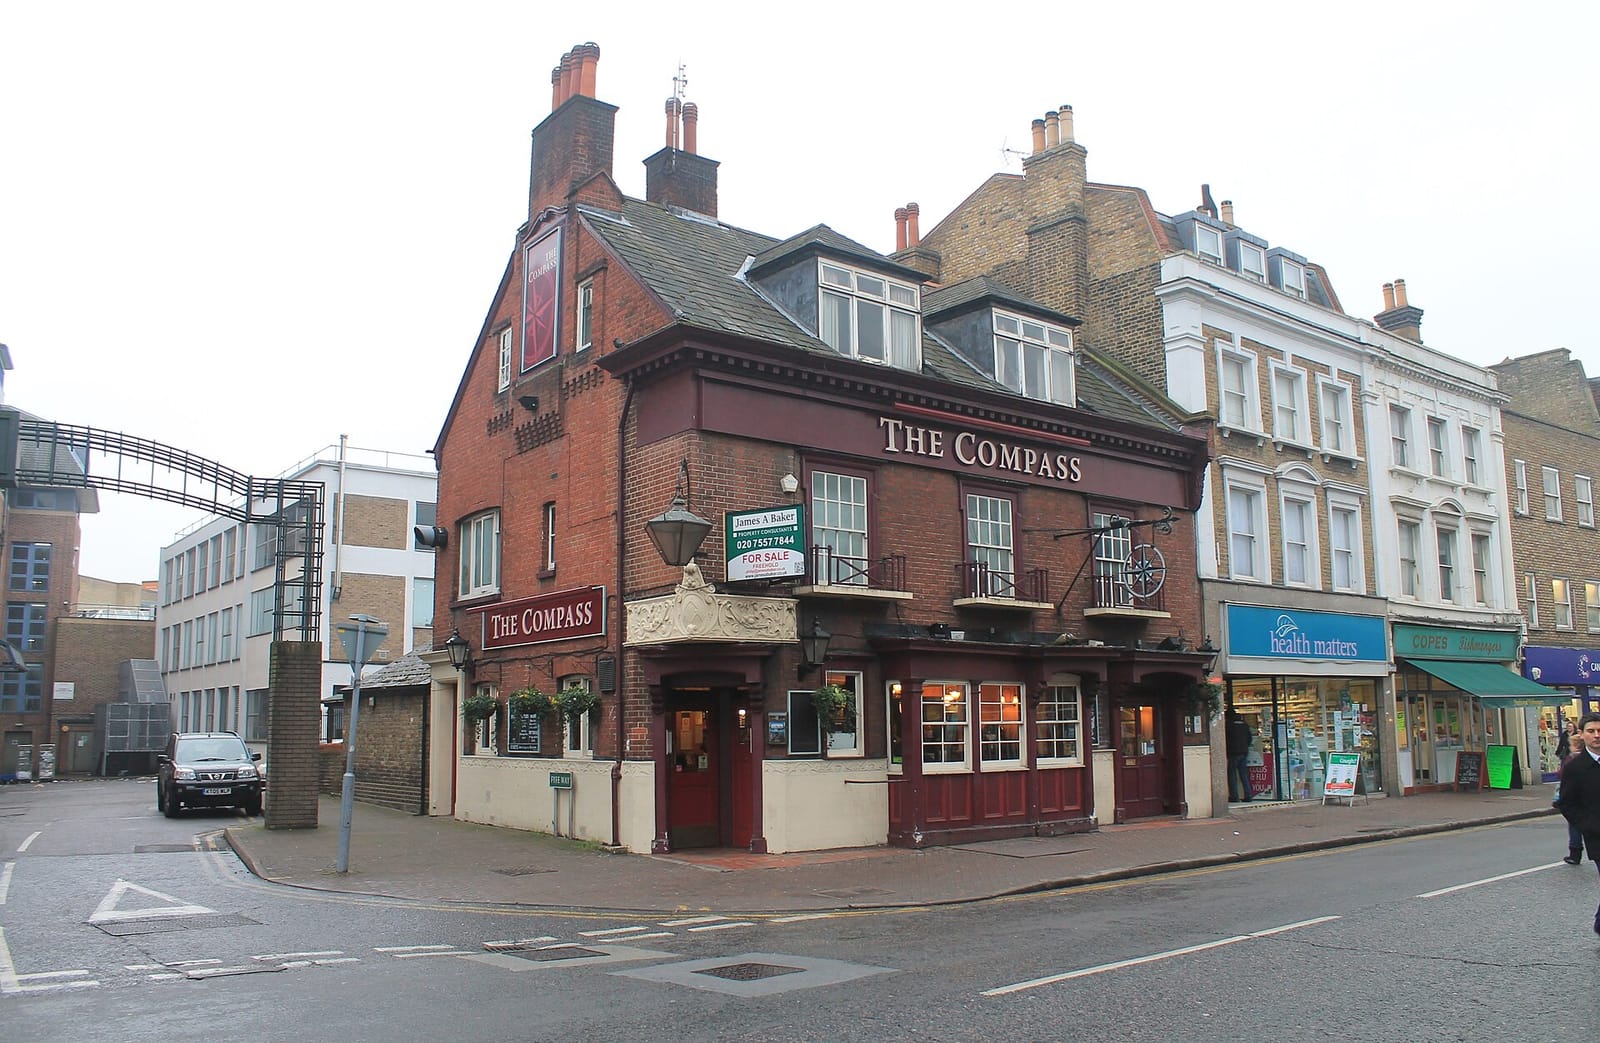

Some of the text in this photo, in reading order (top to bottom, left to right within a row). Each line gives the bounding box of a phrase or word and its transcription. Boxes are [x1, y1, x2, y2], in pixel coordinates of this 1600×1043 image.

[528, 259, 557, 283] COMPASS
[880, 417, 1082, 482] THE COMPASS
[735, 512, 795, 528] James A Baker
[761, 527, 792, 535] CONSULTANTS
[736, 535, 794, 549] 020 7557 7844
[742, 551, 790, 564] FOR SALE
[491, 601, 592, 639] THE COMPASS
[1271, 631, 1357, 657] health matters
[1412, 635, 1448, 650] COPES
